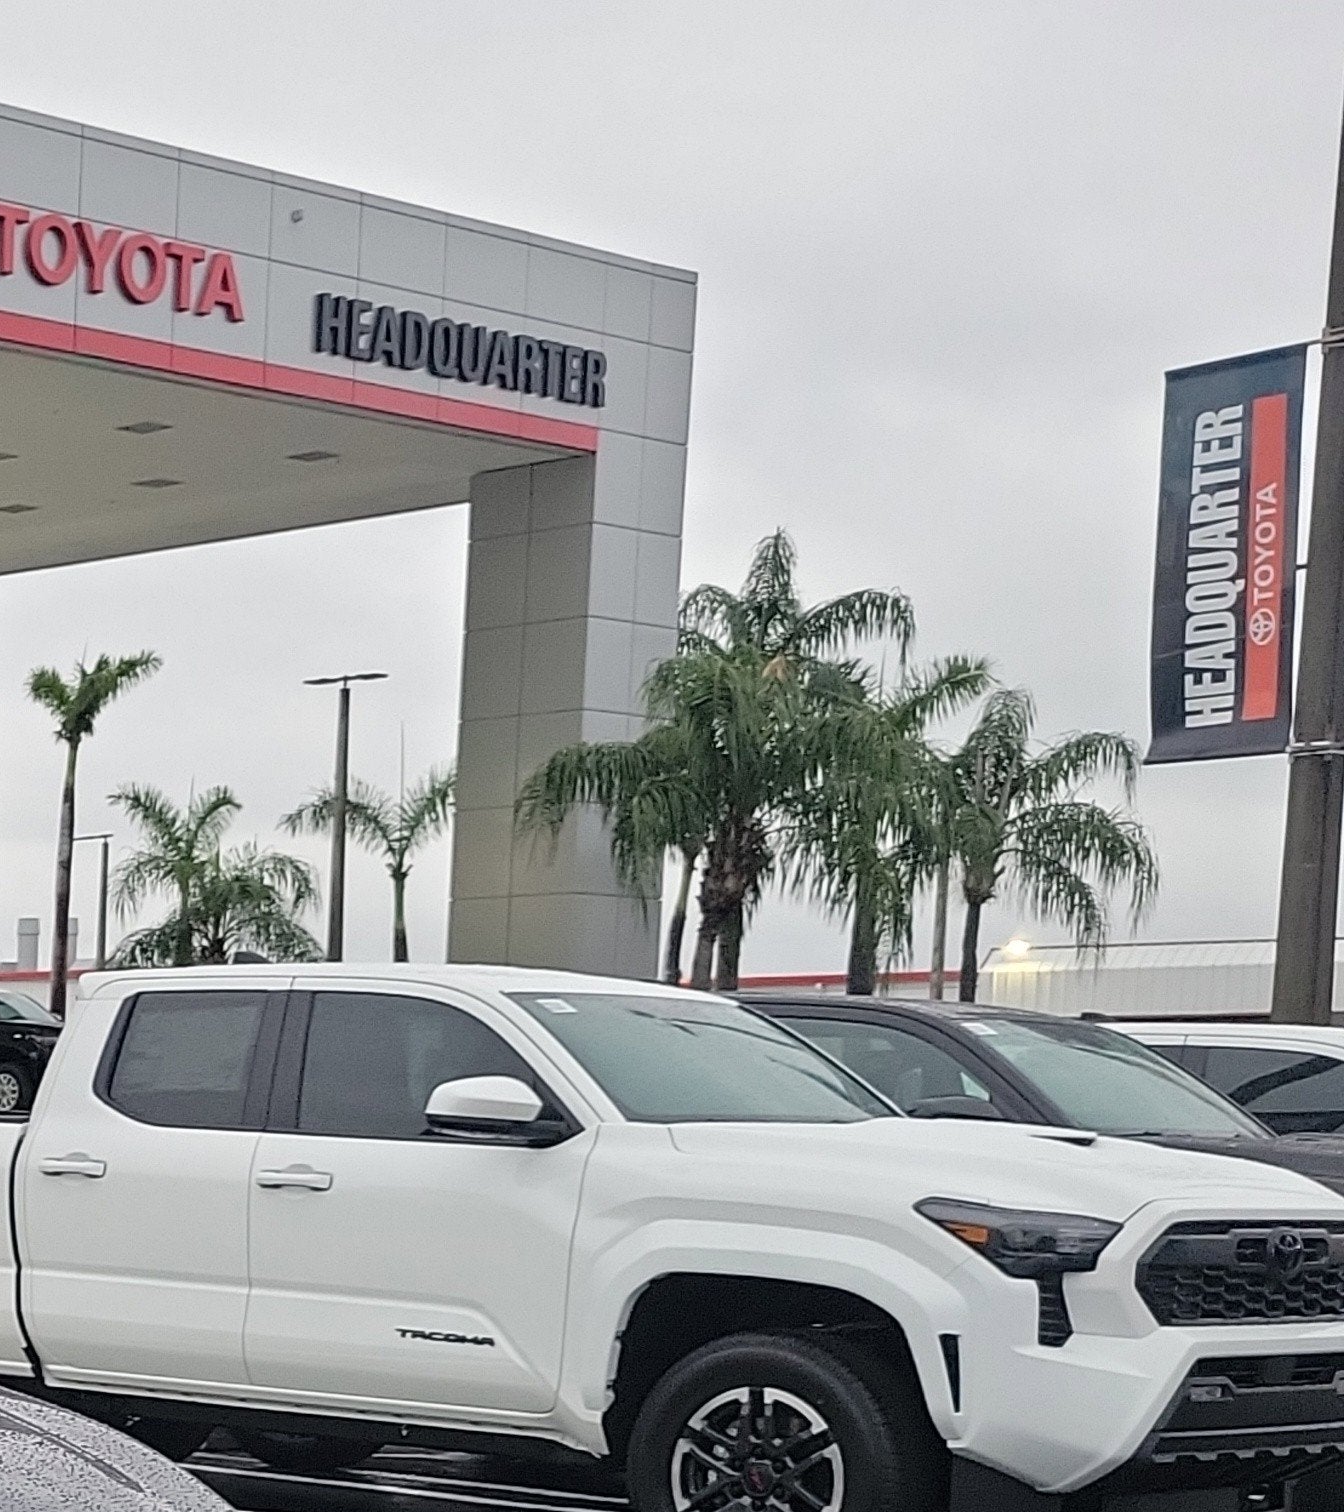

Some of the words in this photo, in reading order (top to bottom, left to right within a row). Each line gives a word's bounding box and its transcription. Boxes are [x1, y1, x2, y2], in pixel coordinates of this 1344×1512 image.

[314, 293, 607, 408] HEADQUARTER
[1184, 403, 1246, 729] HEADQUARTER
[1253, 482, 1278, 606] TOYOTA
[395, 1328, 495, 1347] TACOMA
